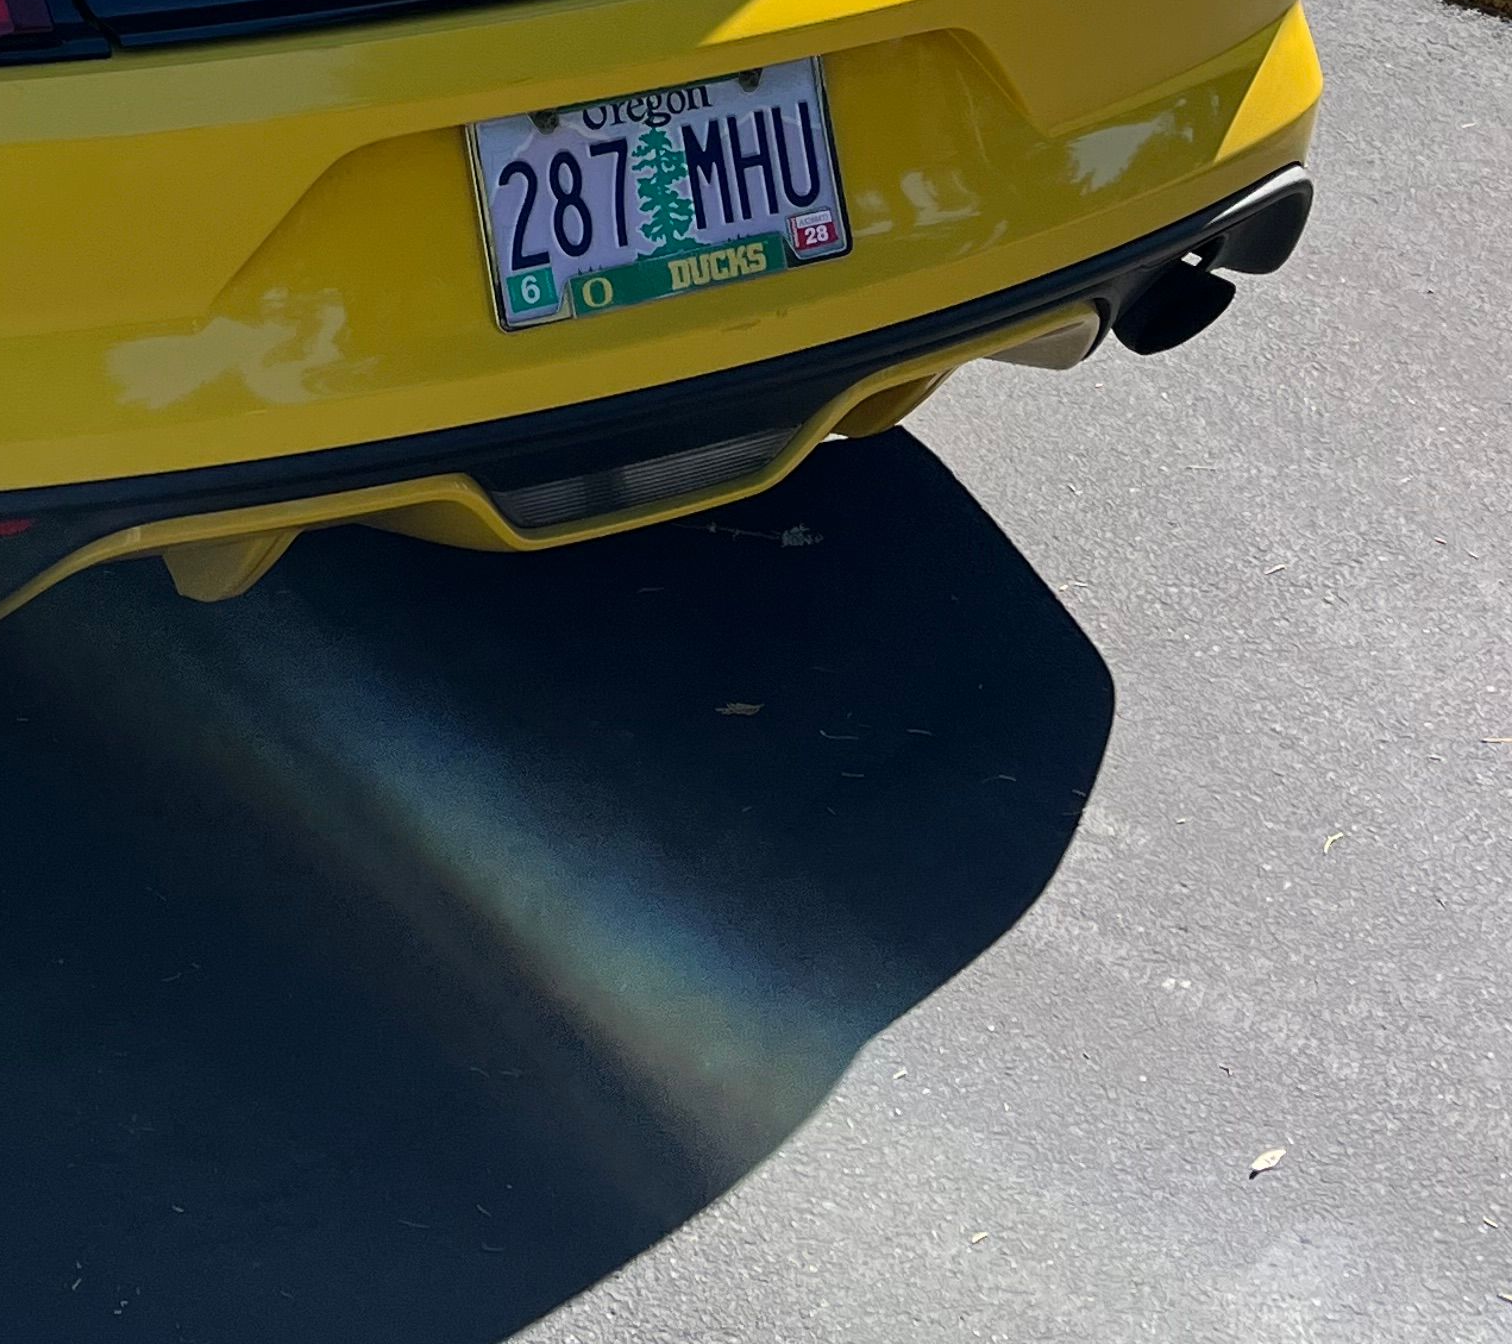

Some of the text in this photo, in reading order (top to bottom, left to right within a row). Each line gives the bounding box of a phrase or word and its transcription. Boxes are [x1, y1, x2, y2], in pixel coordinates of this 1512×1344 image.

[582, 85, 713, 130] Oregon
[497, 101, 822, 271] 287 MHU
[804, 224, 829, 246] 28
[670, 242, 769, 291] DUCKS
[520, 274, 541, 305] 6
